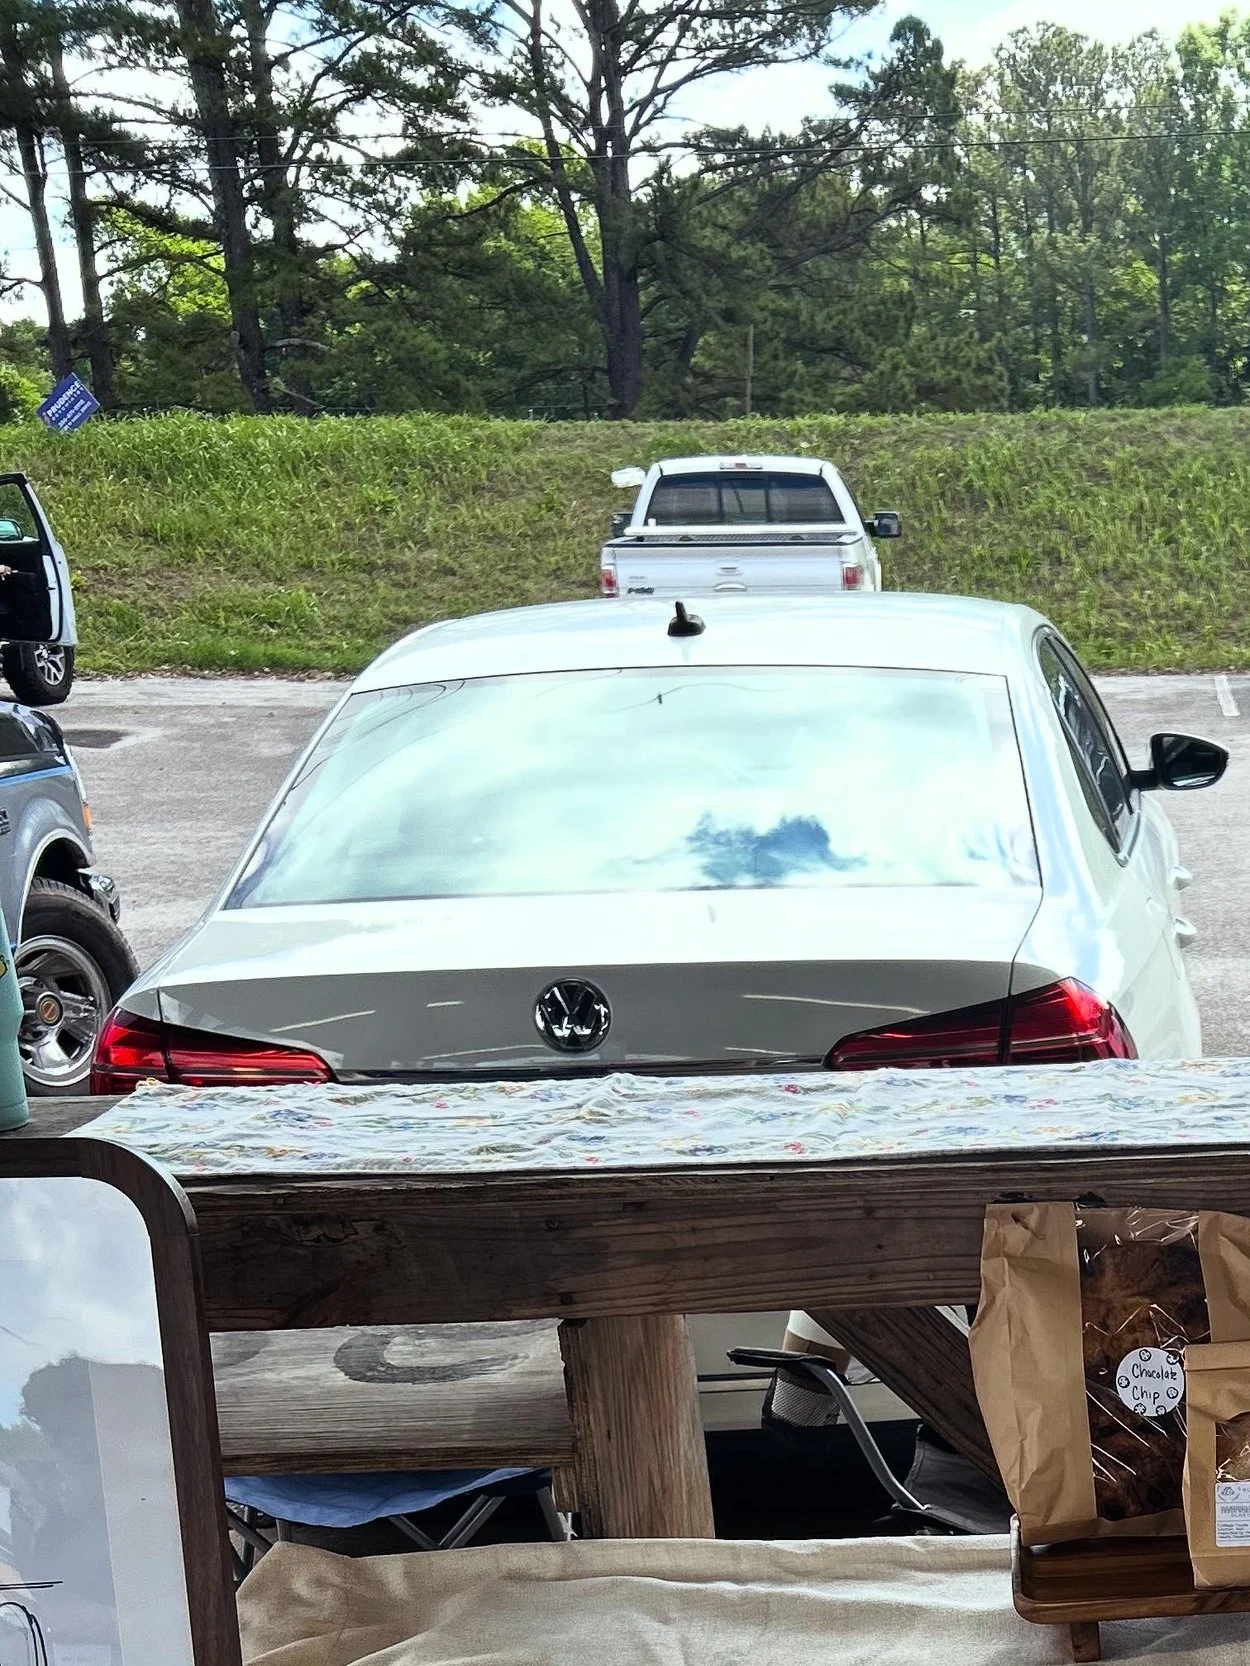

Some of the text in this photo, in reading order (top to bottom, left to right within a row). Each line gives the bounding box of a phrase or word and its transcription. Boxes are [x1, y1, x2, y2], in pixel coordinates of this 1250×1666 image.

[46, 381, 81, 417] PRUDENCE
[1132, 1363, 1177, 1380] Chocolate
[1132, 1385, 1160, 1405] Chip
